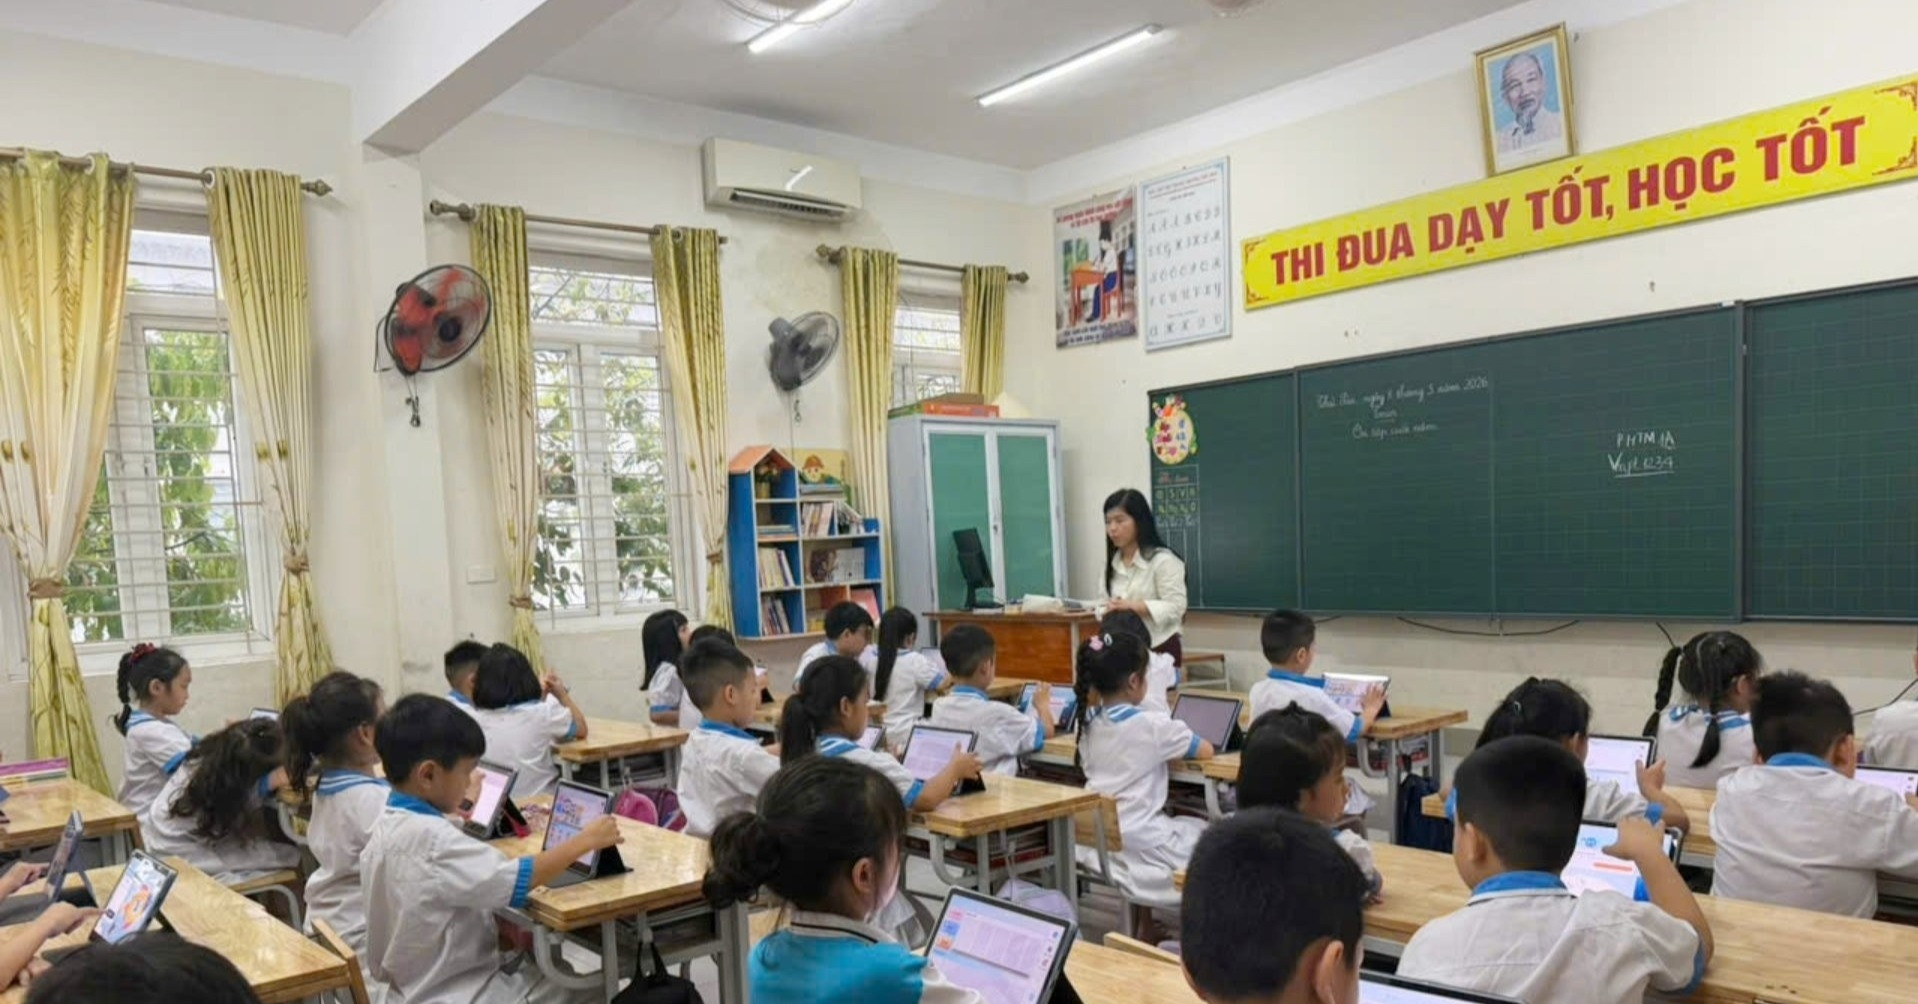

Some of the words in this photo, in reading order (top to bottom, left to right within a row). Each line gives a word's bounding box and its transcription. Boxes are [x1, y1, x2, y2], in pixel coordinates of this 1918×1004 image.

[1271, 242, 1324, 285] THI
[1336, 222, 1415, 272] ĐUA
[1428, 198, 1511, 254] DẠY
[1525, 165, 1614, 231] TỐT,
[1628, 147, 1736, 210] HỌC
[1756, 106, 1866, 182] TỐT
[1463, 375, 1489, 391] 2026
